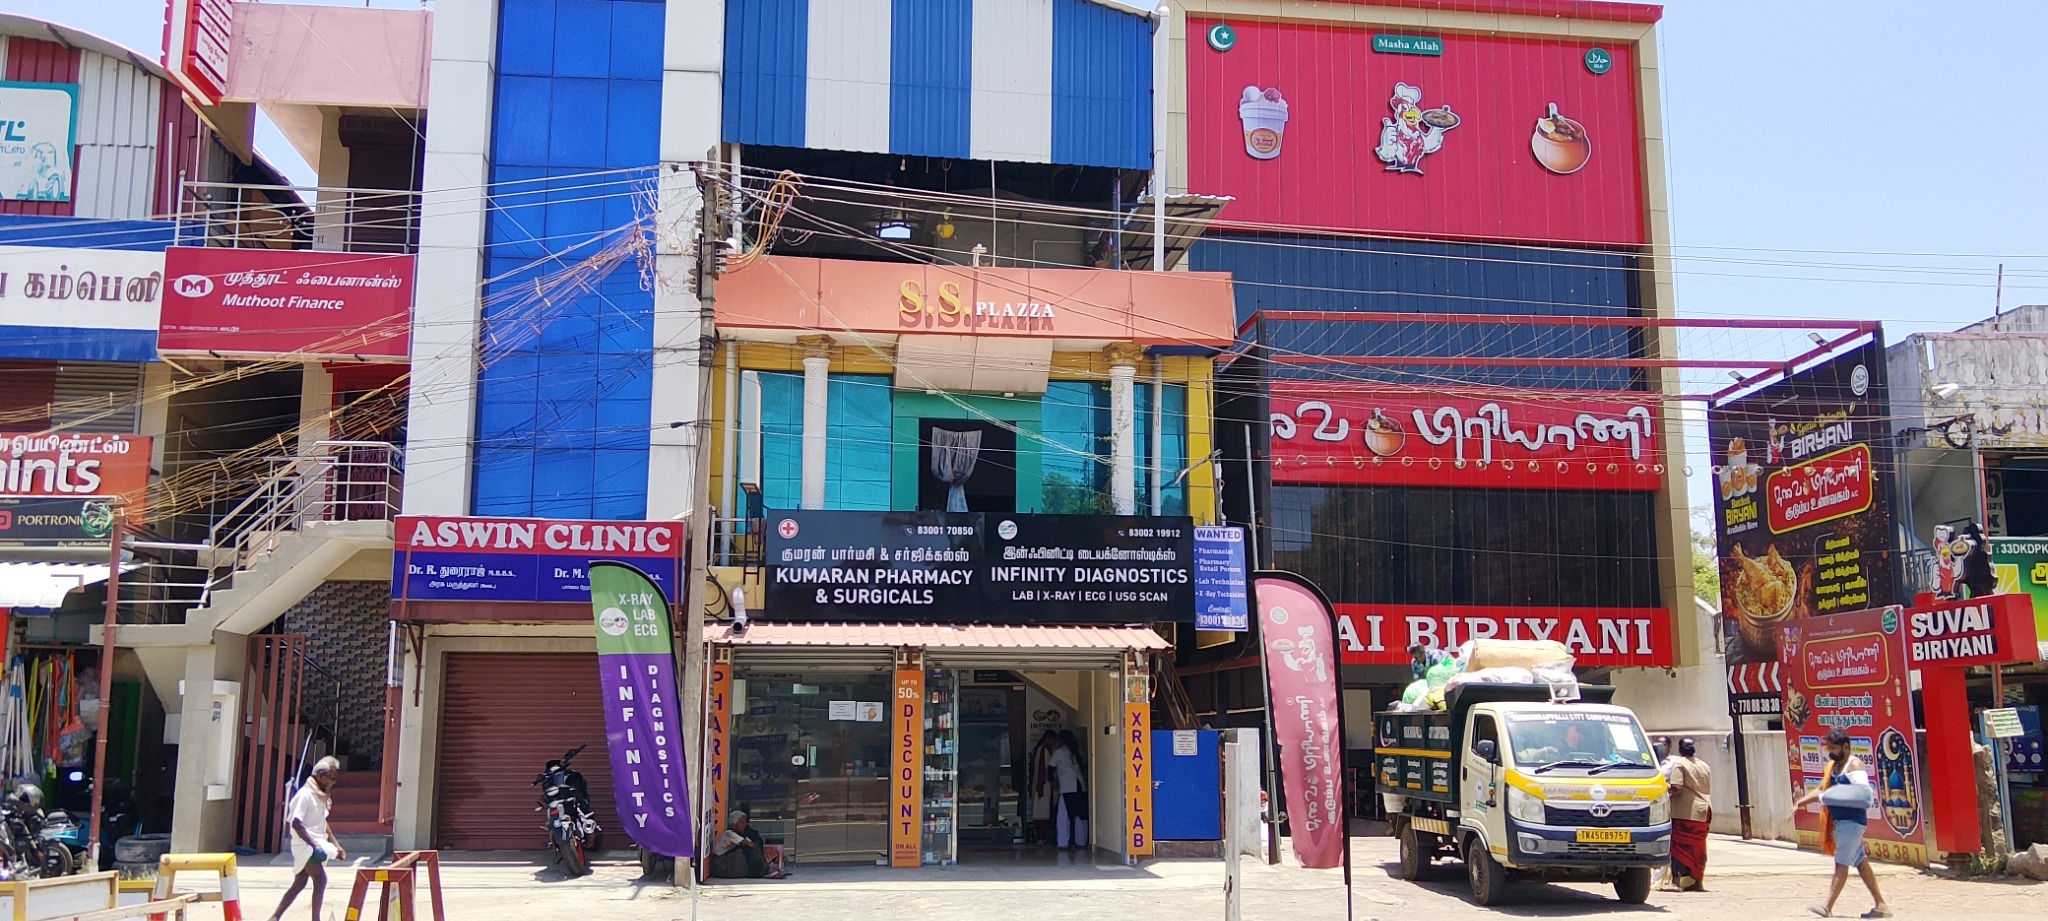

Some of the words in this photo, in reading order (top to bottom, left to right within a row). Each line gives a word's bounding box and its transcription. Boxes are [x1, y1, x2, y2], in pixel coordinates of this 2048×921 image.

[1378, 39, 1410, 49] Masha
[1413, 40, 1439, 51] Allah
[1588, 52, 1608, 63] حلال
[24, 264, 162, 302] கம்பெனி
[223, 269, 288, 288] முத்தூட்
[295, 271, 403, 289] ஃபைனான்ஸ்
[222, 293, 285, 308] Muthoot
[287, 295, 345, 310] Finance
[975, 301, 1056, 318] PLAZZA
[1412, 402, 1651, 464] பிரியாணி
[1791, 421, 1853, 459] BIRYANI
[12, 433, 130, 458] பெயிண்ட்ஸ்
[0, 450, 101, 493] ints
[1810, 486, 1850, 510] உணவகம்
[1726, 501, 1758, 526] BIRYANI
[411, 520, 537, 549] ASWIN
[544, 524, 671, 552] CLINIC
[917, 526, 944, 535] 83001
[947, 526, 974, 536] 70850
[1128, 528, 1154, 537] 83002
[1156, 529, 1181, 538] 19912
[1196, 529, 1241, 540] WANTED
[782, 546, 826, 562] குமரன்
[832, 546, 875, 561] பார்மசி
[880, 547, 890, 560] &
[895, 546, 970, 562] சர்ஜிக்கல்ஸ்
[1003, 545, 1074, 561] இன்ஃபினிட்டி
[1077, 547, 1177, 562] டையக்னோஸ்டிக்ஸ்
[1199, 547, 1234, 555] Pharmacist
[1199, 558, 1230, 566] Pharmacy
[408, 564, 423, 574] Dr.
[426, 565, 437, 574] R.
[440, 564, 486, 578] துரைராஜ்
[554, 568, 569, 578] Dr.
[572, 568, 585, 579] M.
[776, 567, 869, 584] KUMARAN
[875, 569, 974, 585] PHARMACY
[991, 566, 1067, 582] INFINITY
[1074, 568, 1188, 584] DIAGNOSTICS
[1211, 578, 1245, 586] Technician
[618, 593, 653, 606] X-RAY
[815, 588, 829, 604] &
[833, 588, 935, 605] SURGICALS
[1012, 590, 1034, 600] LAB
[1043, 590, 1075, 601] X-RAY
[1085, 591, 1106, 601] ECG
[1115, 592, 1136, 601] USG
[1139, 592, 1168, 602] SCAN
[1217, 590, 1245, 598] Technician
[633, 608, 655, 621] LAB
[1911, 604, 1991, 638] SUVAI
[634, 623, 658, 637] ECG
[1405, 616, 1652, 655] BIRIYANI
[1912, 635, 1994, 661] BIRIYANI
[898, 687, 920, 699] 50%
[1815, 693, 1837, 708] இனிய
[1837, 691, 1873, 709] ரமலான்
[1738, 699, 1751, 713] 770
[1751, 698, 1760, 712] 88
[1760, 698, 1770, 712] 38
[1770, 698, 1780, 712] 38
[1569, 713, 1585, 721] CITY
[1586, 714, 1631, 723] CORPORATION
[618, 665, 649, 828] INFINITY
[648, 665, 675, 817] DIAGNOSTICS
[1131, 712, 1144, 778] XRAY
[901, 704, 915, 836] DISCOUNT
[1134, 785, 1141, 793] &
[1132, 797, 1144, 848] LAB
[1580, 831, 1628, 840] TN45CB9757
[1874, 842, 1890, 859] 38
[1893, 844, 1910, 861] 38
